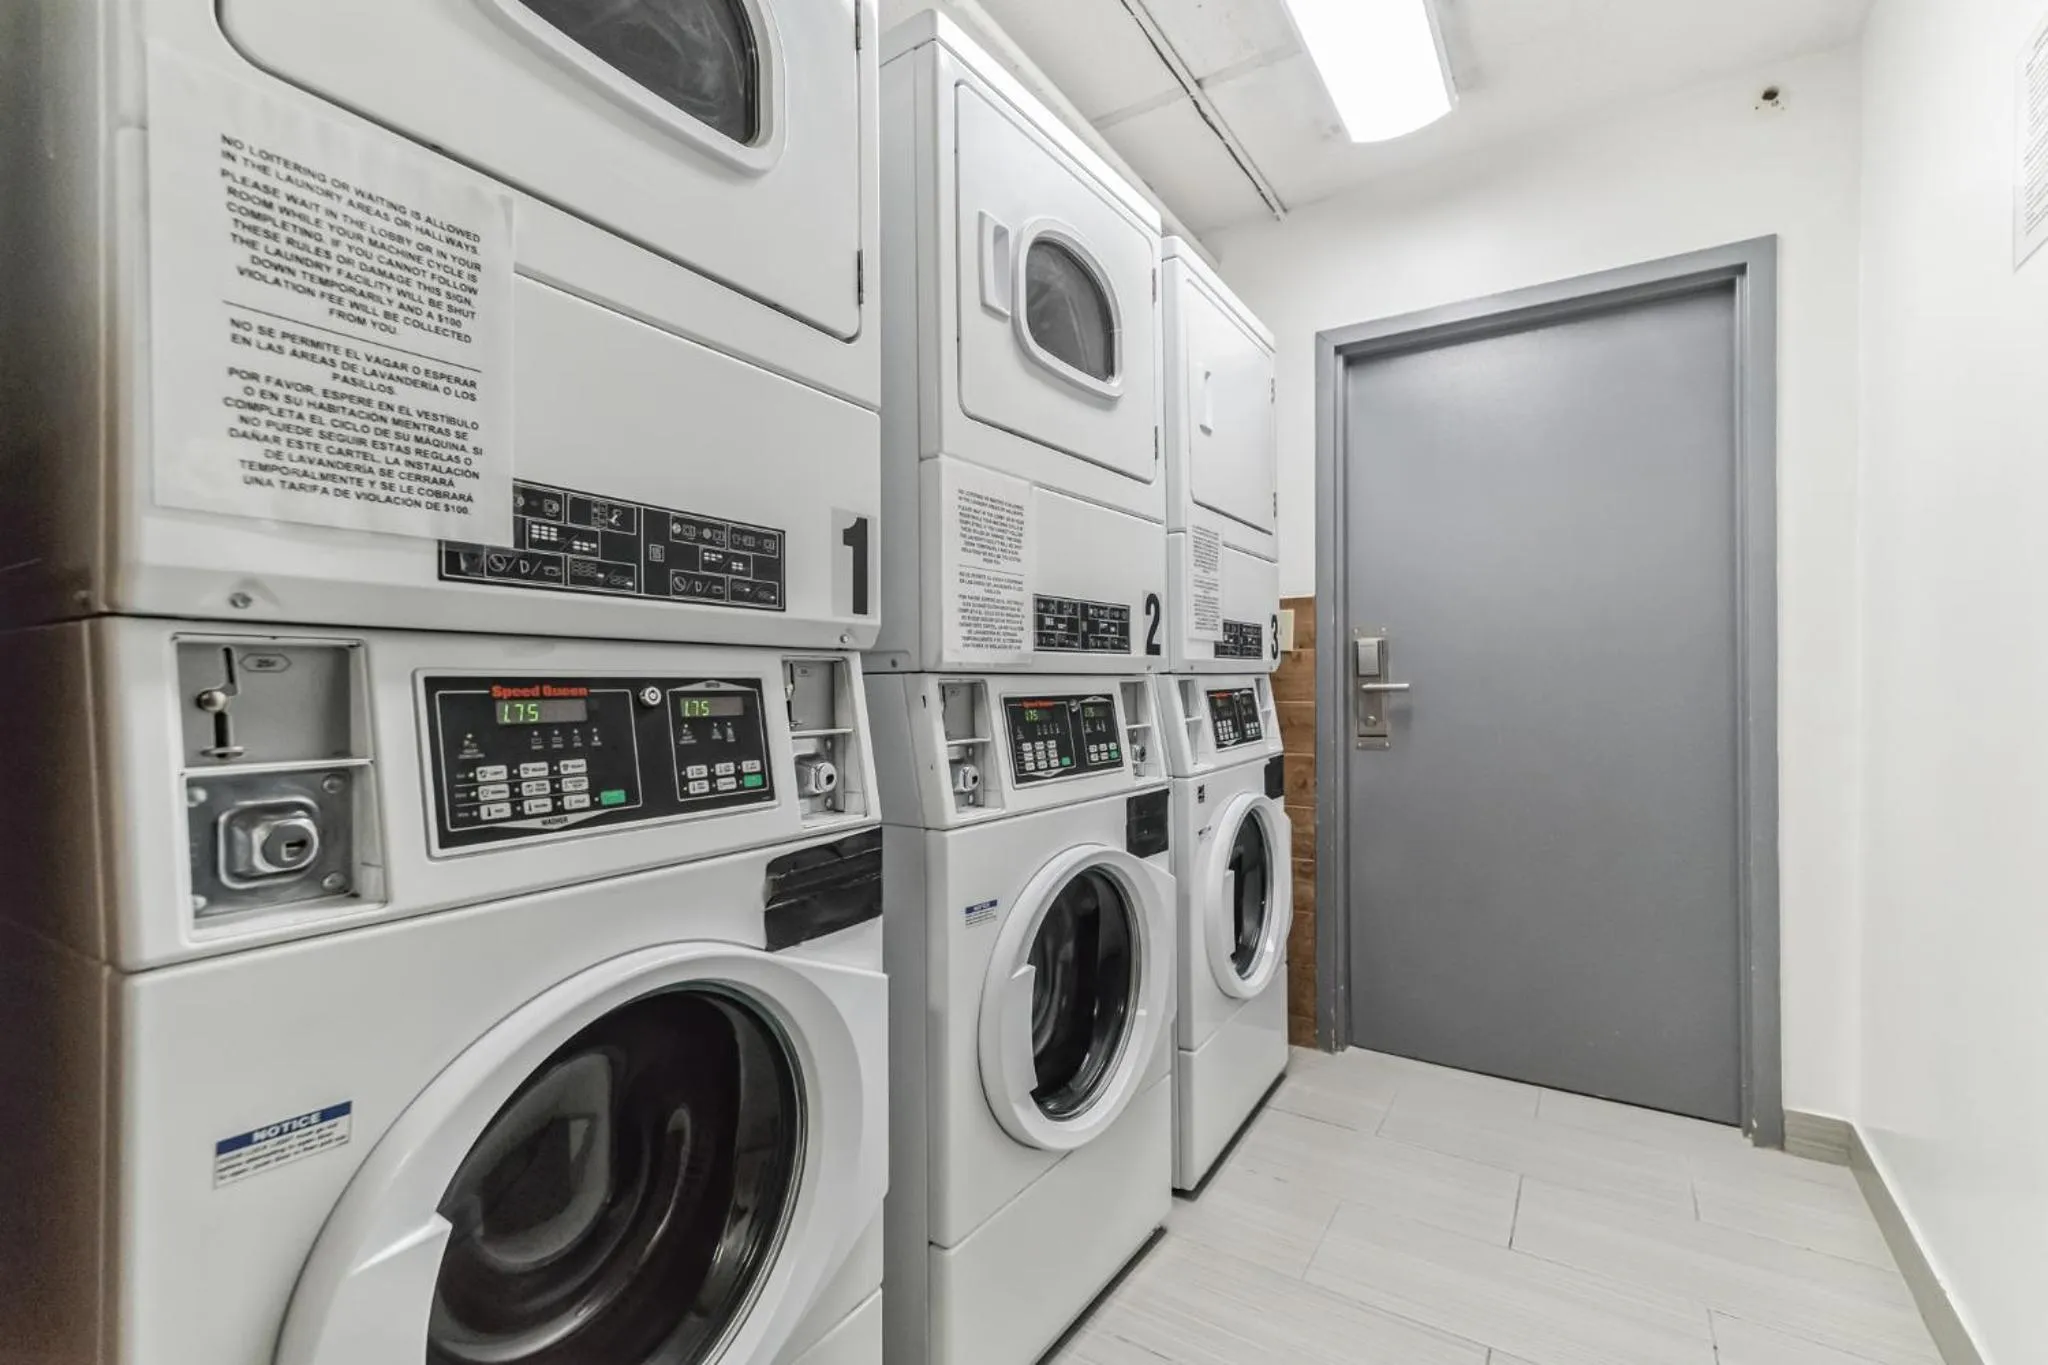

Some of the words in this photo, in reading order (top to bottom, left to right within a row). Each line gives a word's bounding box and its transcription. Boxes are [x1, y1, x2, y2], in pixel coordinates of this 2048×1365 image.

[221, 133, 244, 150] NO
[249, 145, 326, 183] LOITERING
[330, 178, 349, 192] OR
[354, 187, 407, 215] WAITING
[410, 210, 421, 221] IS
[424, 215, 480, 243] ALLOWED
[221, 149, 236, 162] IN
[242, 156, 271, 176] THE
[275, 170, 342, 202] LAUNDRY
[346, 198, 390, 221] AREAS
[393, 216, 412, 230] OR
[220, 168, 280, 199] PLEASE
[284, 192, 320, 212] WAIT
[324, 207, 337, 220] IN
[341, 213, 367, 231] THE
[370, 224, 412, 246] LOBBY
[415, 241, 433, 255] OR
[436, 248, 447, 260] IN
[449, 253, 481, 272] YOUR
[226, 185, 274, 210] ROOM
[277, 205, 322, 228] WHILE
[327, 222, 364, 243] YOUR
[366, 236, 424, 265] MACHINE
[426, 258, 464, 279] CYCLE
[466, 270, 477, 283] IS
[230, 232, 259, 250] THE
[263, 244, 332, 273] LAUNDRY
[336, 267, 392, 293] FACILITY
[395, 287, 424, 305] WILL
[427, 297, 444, 310] BE
[446, 303, 476, 320] SHUT
[232, 217, 280, 243] THESE
[285, 235, 332, 260] RULES
[335, 253, 355, 268] OR
[358, 261, 412, 287] DAMAGE
[415, 280, 442, 297] THIS
[345, 243, 373, 260] YOU
[376, 254, 427, 278] CANNOT
[430, 272, 478, 295] FOLLOW
[236, 266, 315, 297] VIOLATION
[319, 290, 344, 306] FEE
[348, 299, 379, 317] WILL
[382, 309, 399, 323] BE
[402, 316, 471, 343] COLLECTED
[250, 254, 296, 277] DOWN
[300, 269, 394, 306] TEMPORARILY
[397, 301, 423, 316] AND
[425, 310, 434, 320] A
[437, 312, 462, 328] $100
[328, 307, 367, 326] FROM
[229, 317, 253, 332] NO
[256, 324, 275, 338] SE
[280, 330, 341, 355] PERMITE
[344, 347, 361, 360] EL
[363, 352, 408, 372] VAGAR
[411, 365, 421, 375] O
[423, 367, 477, 389] ESPERAR
[230, 332, 252, 347] EN
[255, 339, 284, 355] LAS
[340, 360, 358, 373] DE
[442, 385, 451, 395] O
[454, 389, 476, 402] LOS
[227, 366, 260, 383] POR
[320, 388, 374, 408] ESPERE
[377, 400, 394, 412] EN
[397, 404, 413, 417] EL
[243, 385, 255, 396] O
[258, 388, 279, 401] EN
[283, 393, 303, 406] SU
[390, 416, 451, 437] MIENTRAS
[453, 429, 468, 441] SE
[222, 396, 305, 421] COMPLETA
[308, 413, 325, 426] EL
[329, 417, 370, 433] CICLO
[373, 426, 391, 439] DE
[393, 430, 410, 442] SU
[472, 445, 482, 455] SI
[238, 414, 261, 427] NO
[265, 419, 313, 437] PUEDE
[317, 429, 368, 447] SEGUIR
[370, 439, 411, 455] ESTAS
[414, 447, 461, 464] REGLAS
[463, 456, 472, 466] O
[285, 437, 322, 453] ESTE
[384, 455, 400, 466] LA
[239, 459, 364, 487] TEMPORALMENTE
[367, 479, 376, 488] Y
[379, 480, 396, 492] SE
[398, 484, 414, 494] LE
[416, 486, 473, 503] COBRARÁ
[263, 448, 284, 461] DE
[378, 467, 394, 478] SE
[243, 475, 274, 487] UNA
[279, 479, 329, 495] TARIFA
[332, 487, 350, 499] DE
[424, 500, 440, 511] DE
[842, 516, 868, 615] 1
[1145, 593, 1161, 656] 2
[1271, 614, 1279, 660] 3
[492, 685, 540, 698] Speed
[543, 685, 588, 697] Queen
[252, 1112, 322, 1143] NOTICE
